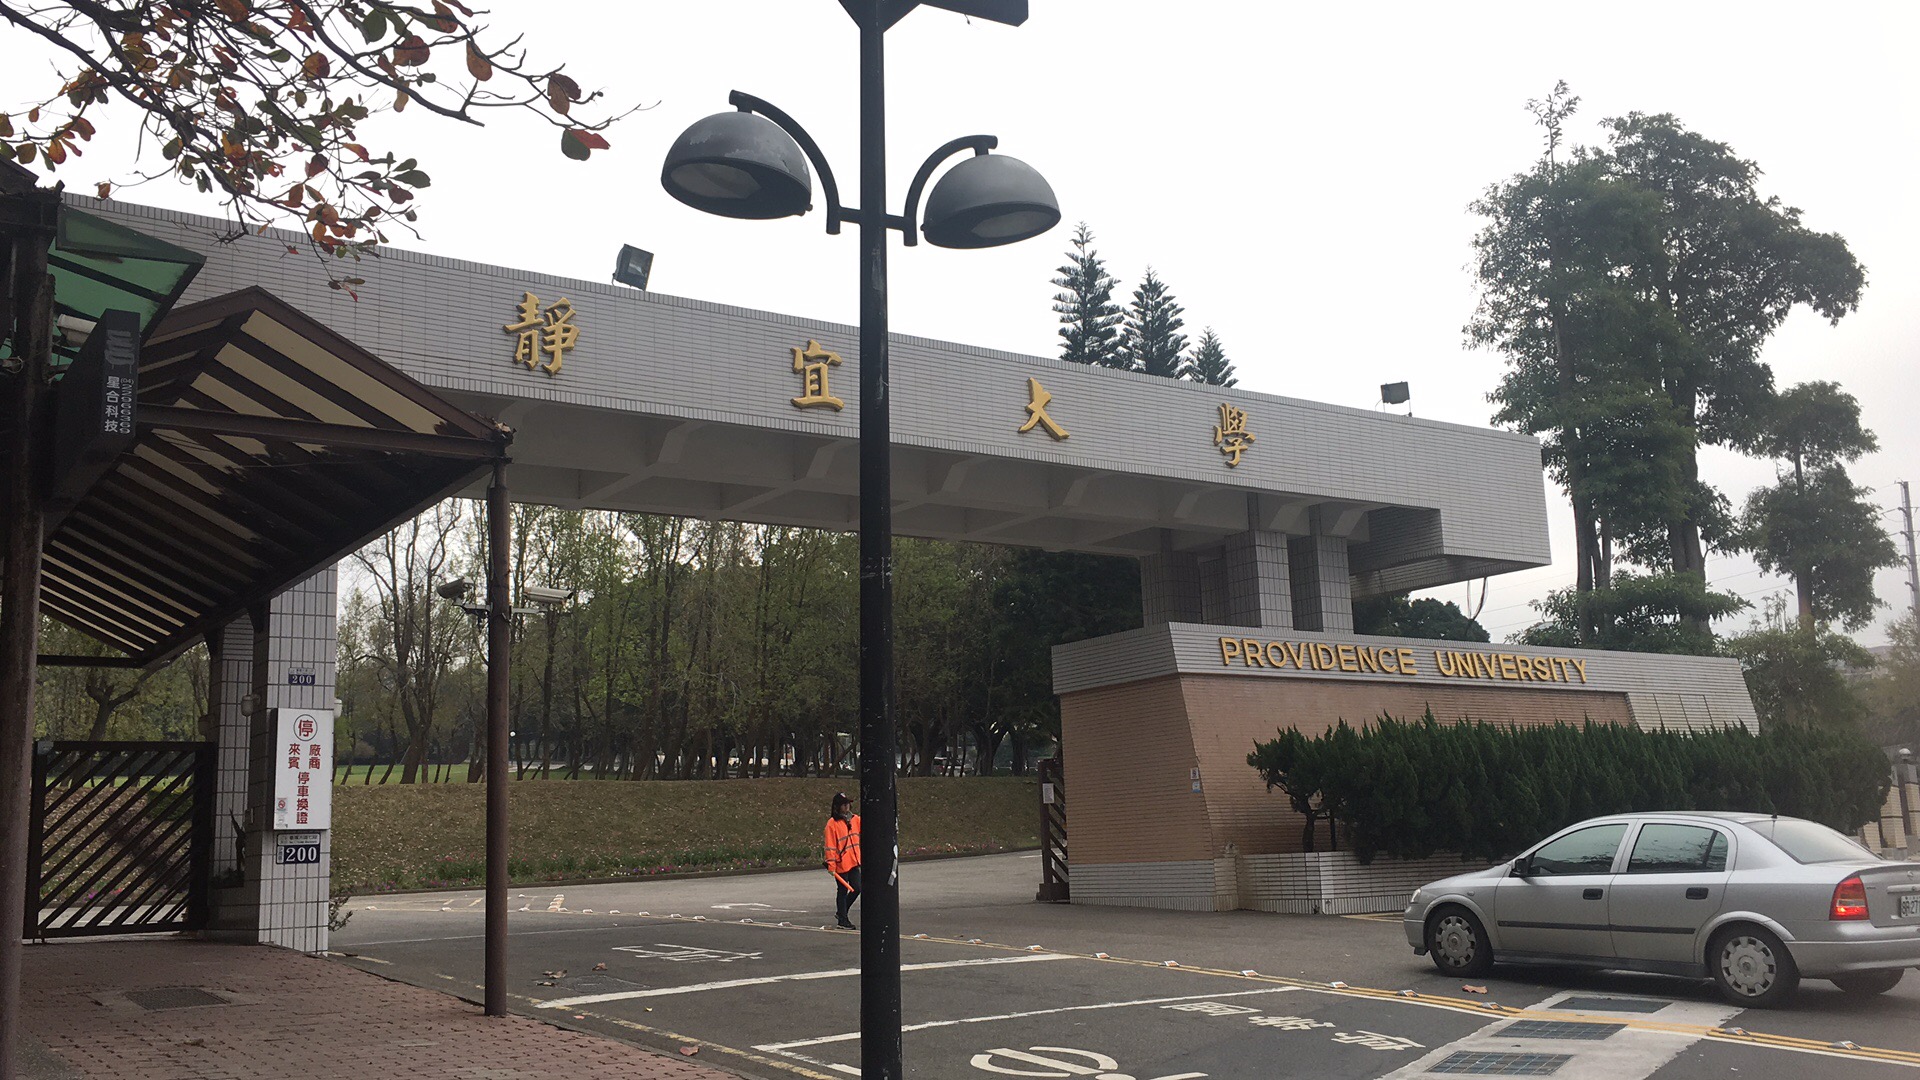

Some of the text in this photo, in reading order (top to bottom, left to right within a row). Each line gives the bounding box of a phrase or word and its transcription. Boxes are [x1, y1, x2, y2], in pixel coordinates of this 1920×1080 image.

[503, 291, 1256, 469] 靜宜大學
[104, 375, 120, 433] 星合科技
[1219, 636, 1587, 684] PROVIDENCE UNIVERSITY
[292, 675, 312, 684] 200
[298, 719, 314, 737] 停
[288, 743, 301, 770] 來賓
[309, 744, 321, 770] 廠商
[296, 771, 310, 825] 停車換證
[286, 846, 317, 862] 200
